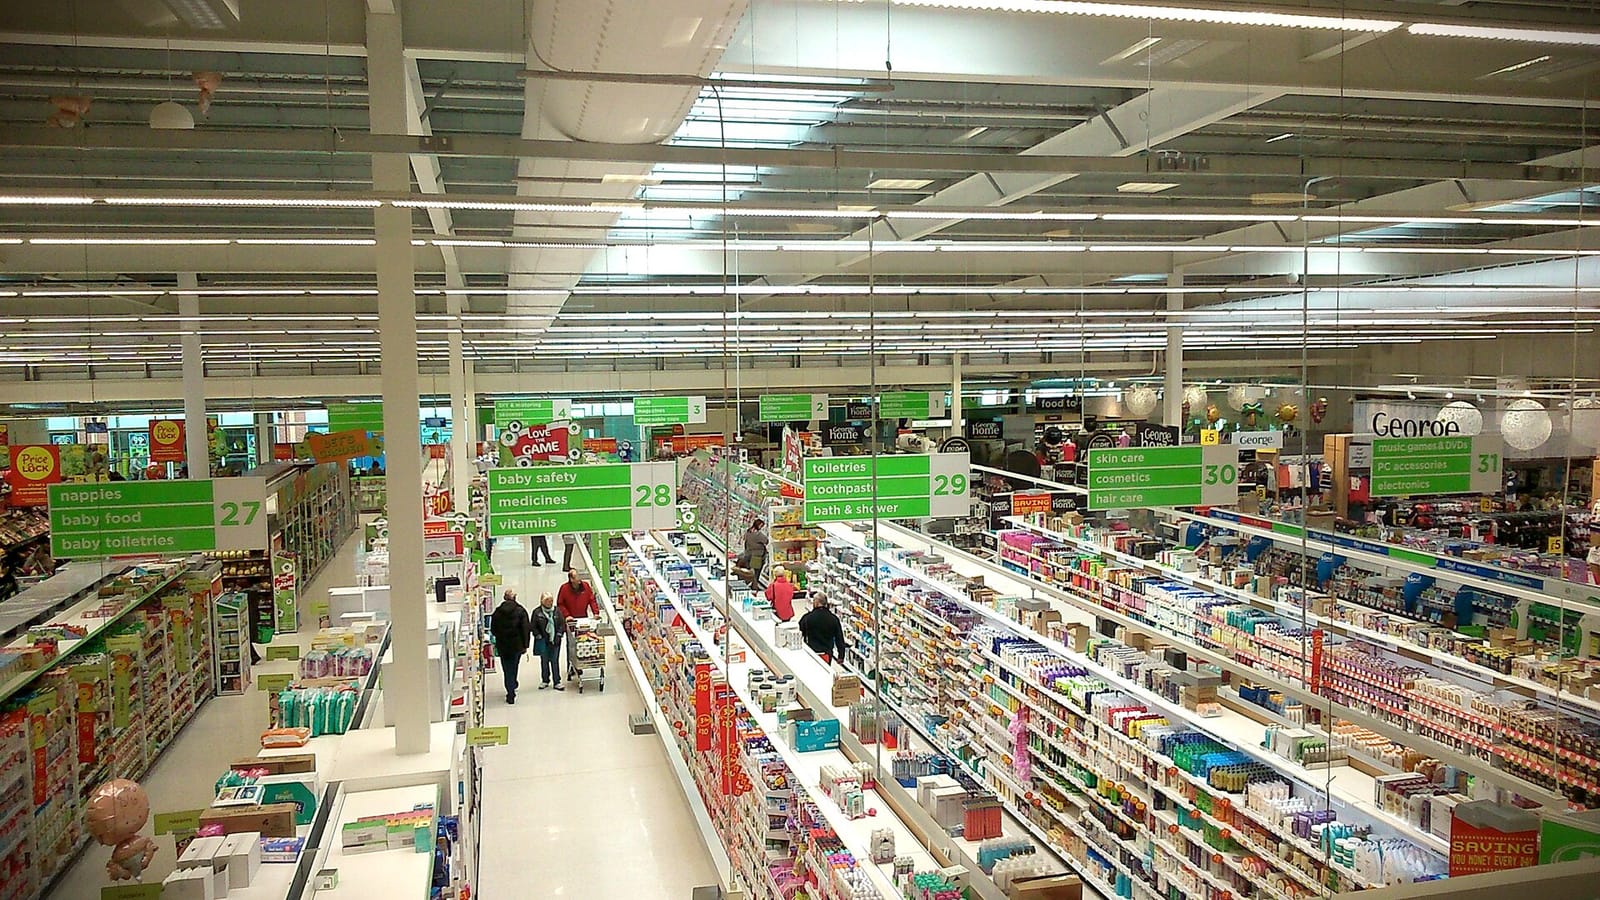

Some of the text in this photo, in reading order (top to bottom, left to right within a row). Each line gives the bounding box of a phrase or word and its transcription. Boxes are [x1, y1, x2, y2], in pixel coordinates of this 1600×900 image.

[693, 405, 701, 415] 3
[816, 402, 824, 412] 2
[934, 399, 939, 409] 1
[1041, 400, 1077, 408] food to
[558, 408, 567, 418] 4
[156, 425, 176, 434] Price
[972, 424, 1000, 435] home
[1372, 411, 1461, 438] George
[527, 430, 552, 440] LOVE
[829, 428, 859, 440] home
[1144, 428, 1172, 443] George
[1239, 435, 1274, 446] George
[523, 442, 560, 455] GAME
[1378, 443, 1405, 453] music
[21, 453, 49, 465] Price
[1095, 454, 1145, 464] skin care
[1477, 454, 1498, 473] 31
[22, 462, 49, 473] LOCK
[812, 462, 866, 474] toiletries
[1377, 460, 1447, 471] PC accessories
[498, 471, 577, 485] baby safety
[1095, 473, 1151, 484] cosmetics
[1203, 464, 1235, 485] 30
[933, 474, 966, 496] 29
[1378, 480, 1430, 491] electronics
[60, 488, 123, 504] nappies
[498, 495, 569, 508] medicines
[635, 485, 671, 508] 28
[1095, 493, 1144, 503] hair care
[219, 500, 261, 527] 27
[812, 506, 840, 516] bath
[843, 505, 854, 515] &
[61, 511, 142, 528] baby food
[498, 517, 558, 530] vitamins
[61, 533, 175, 552] baby toiletries
[1452, 841, 1534, 854] SAVING
[1452, 853, 1466, 865] YOU
[1468, 854, 1491, 866] MONEY
[1494, 855, 1517, 867] EVERY
